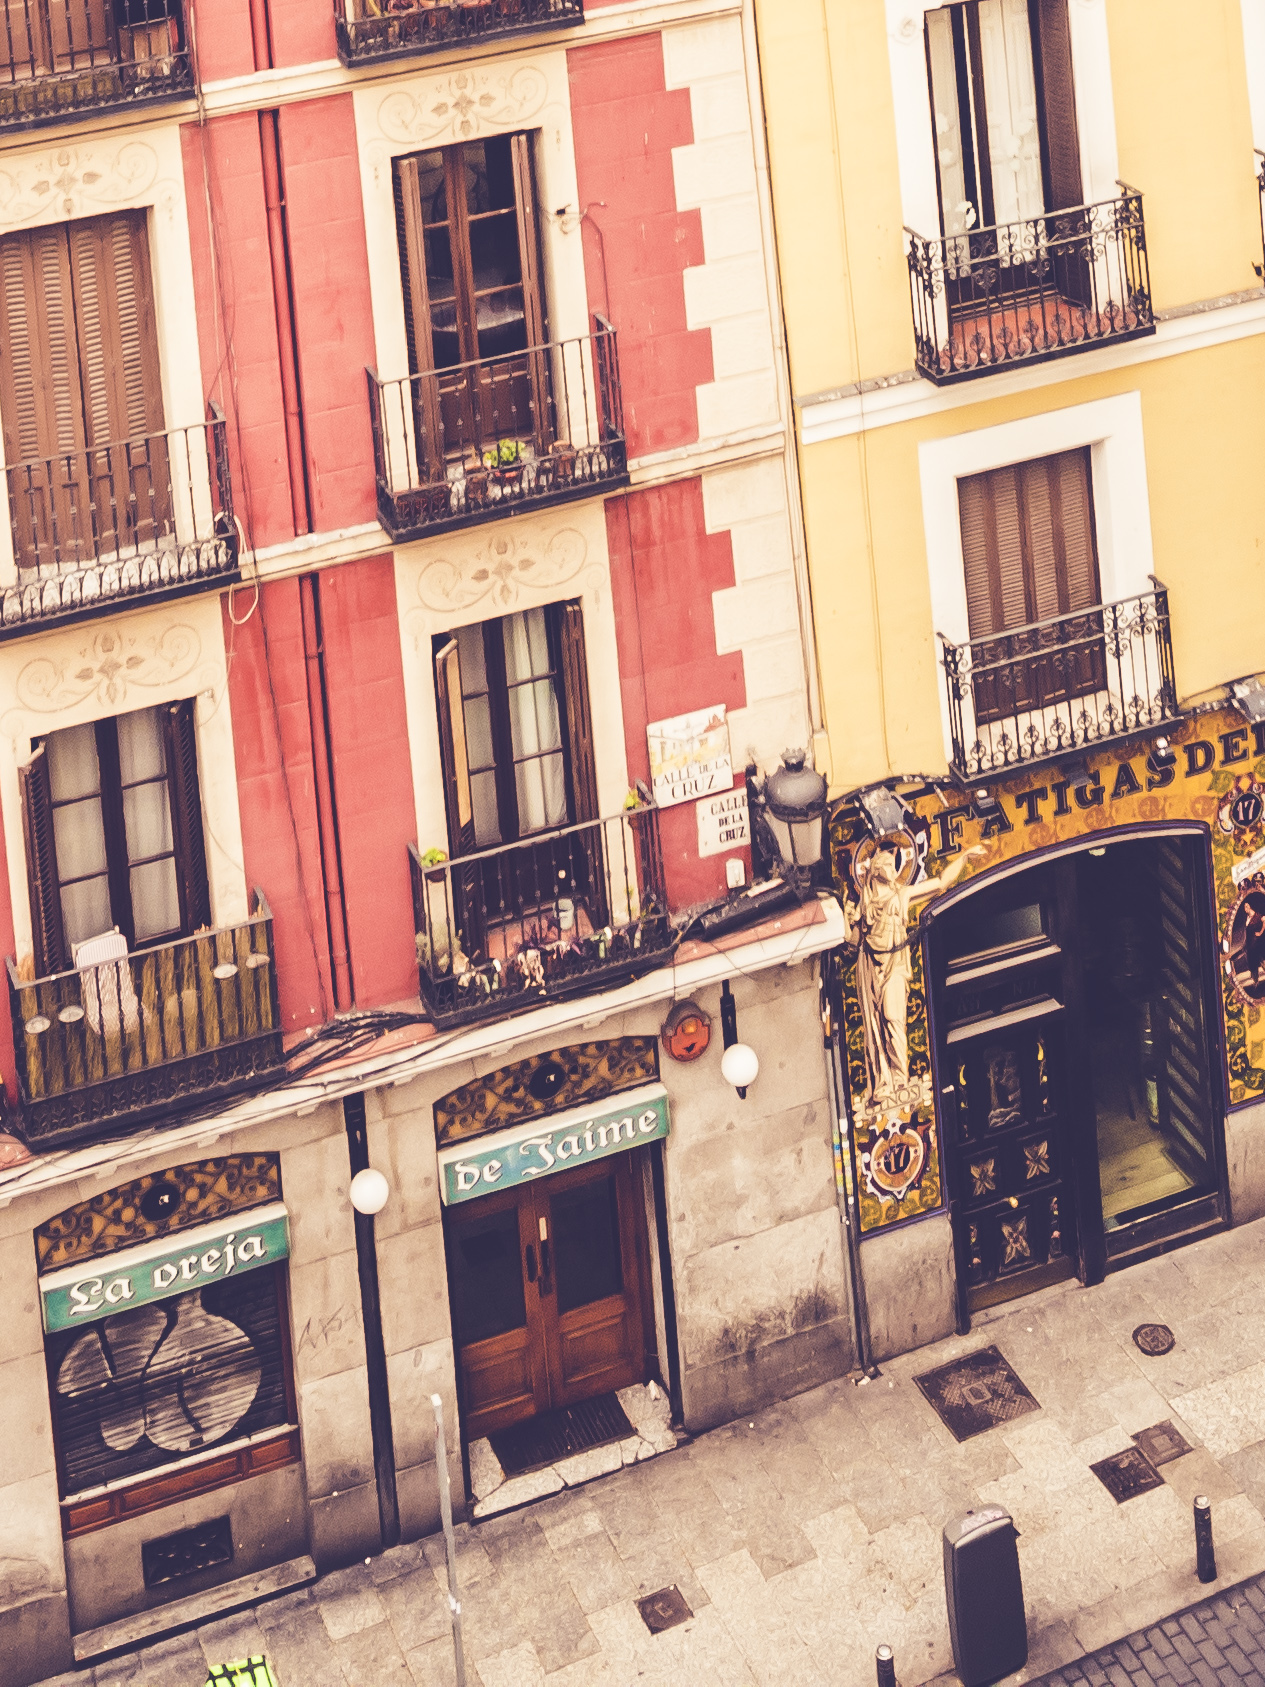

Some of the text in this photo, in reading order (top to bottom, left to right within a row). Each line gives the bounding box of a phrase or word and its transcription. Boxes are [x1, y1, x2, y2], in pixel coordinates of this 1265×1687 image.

[653, 758, 730, 789] CALLE DE LA
[671, 775, 717, 800] CRUZ
[710, 794, 748, 816] CALLE
[1237, 798, 1256, 822] 17
[718, 814, 744, 828] DE LA
[719, 826, 746, 844] CRUZ
[519, 1109, 659, 1177] Jaime
[69, 1233, 267, 1317] La oreja
